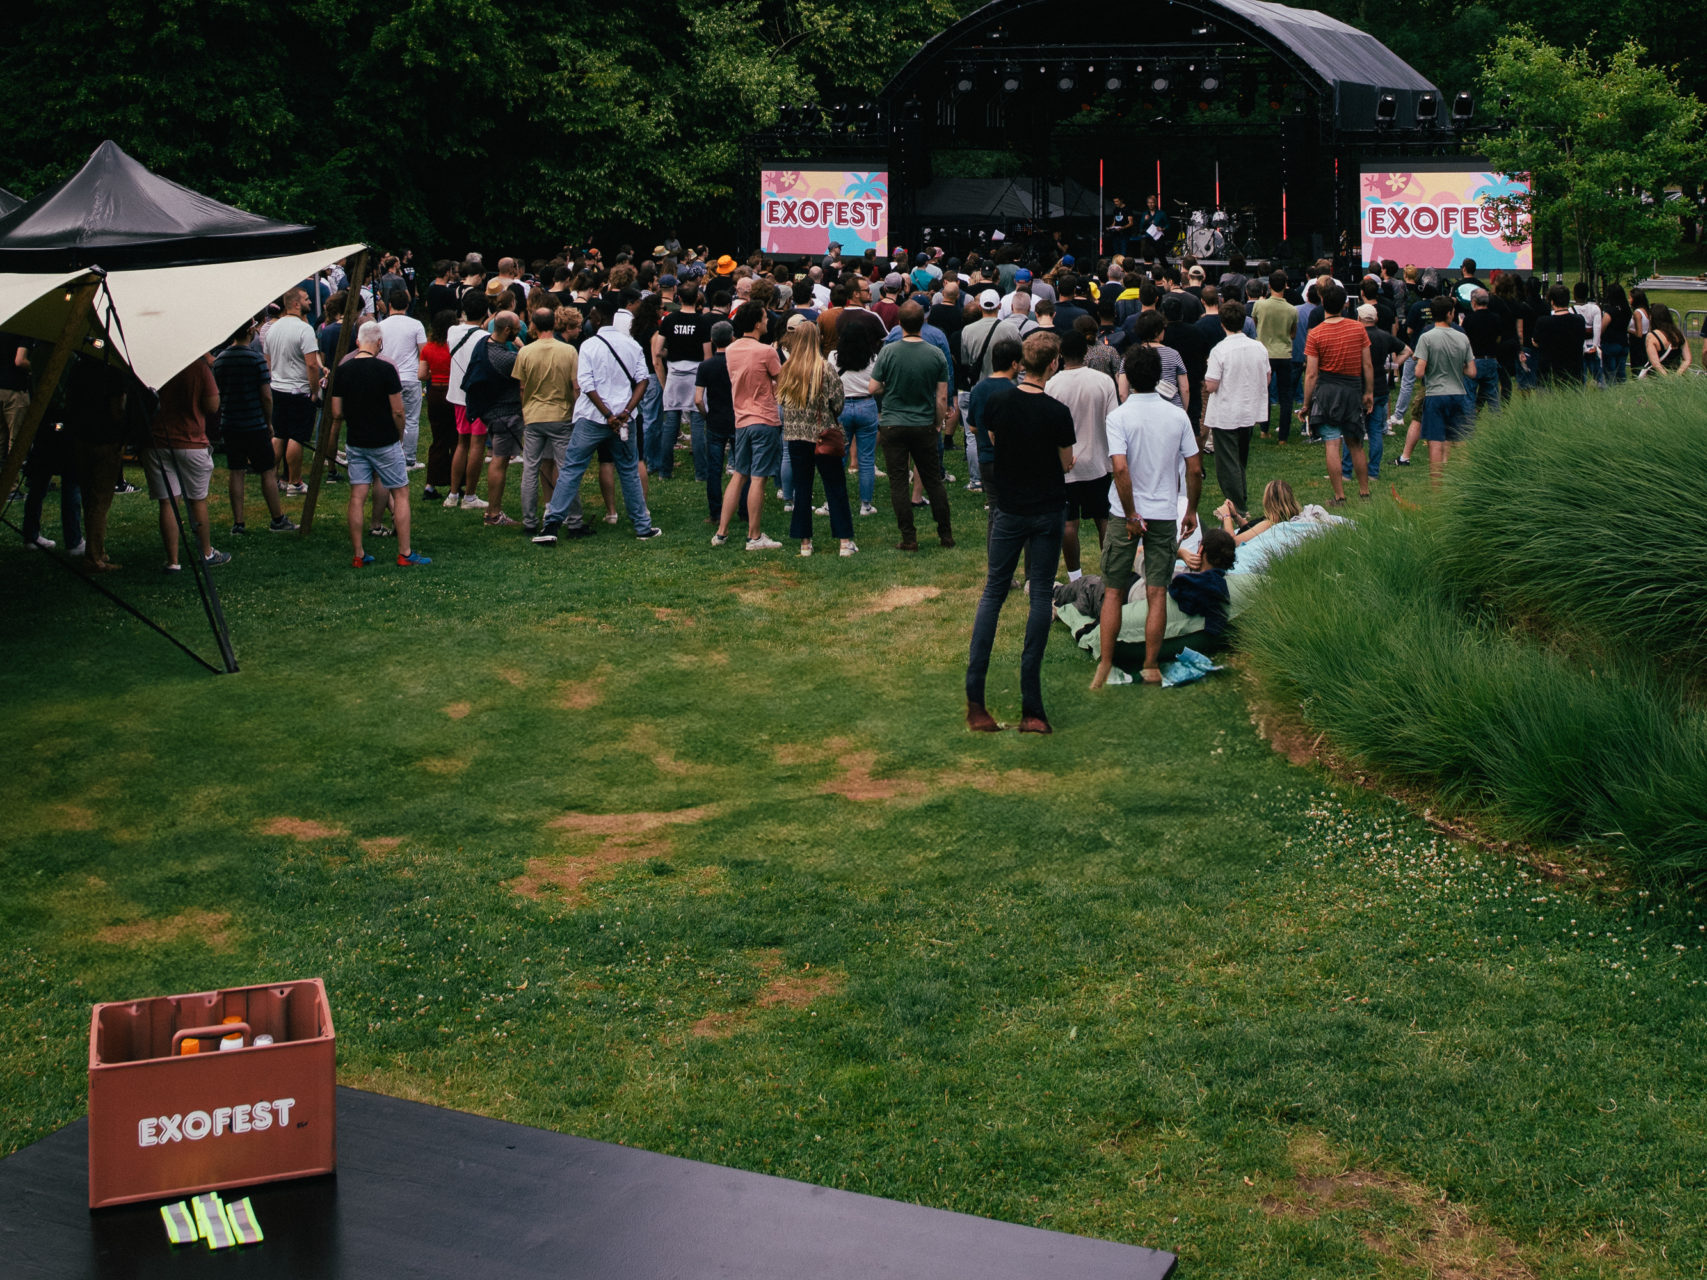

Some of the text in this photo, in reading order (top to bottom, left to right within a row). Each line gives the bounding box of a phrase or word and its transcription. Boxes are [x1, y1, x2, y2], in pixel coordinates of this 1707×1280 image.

[766, 200, 884, 227] EXOFEST
[1368, 206, 1524, 235] EXOFEST
[673, 324, 696, 335] STAFF
[138, 1098, 296, 1147] EXOFEST
